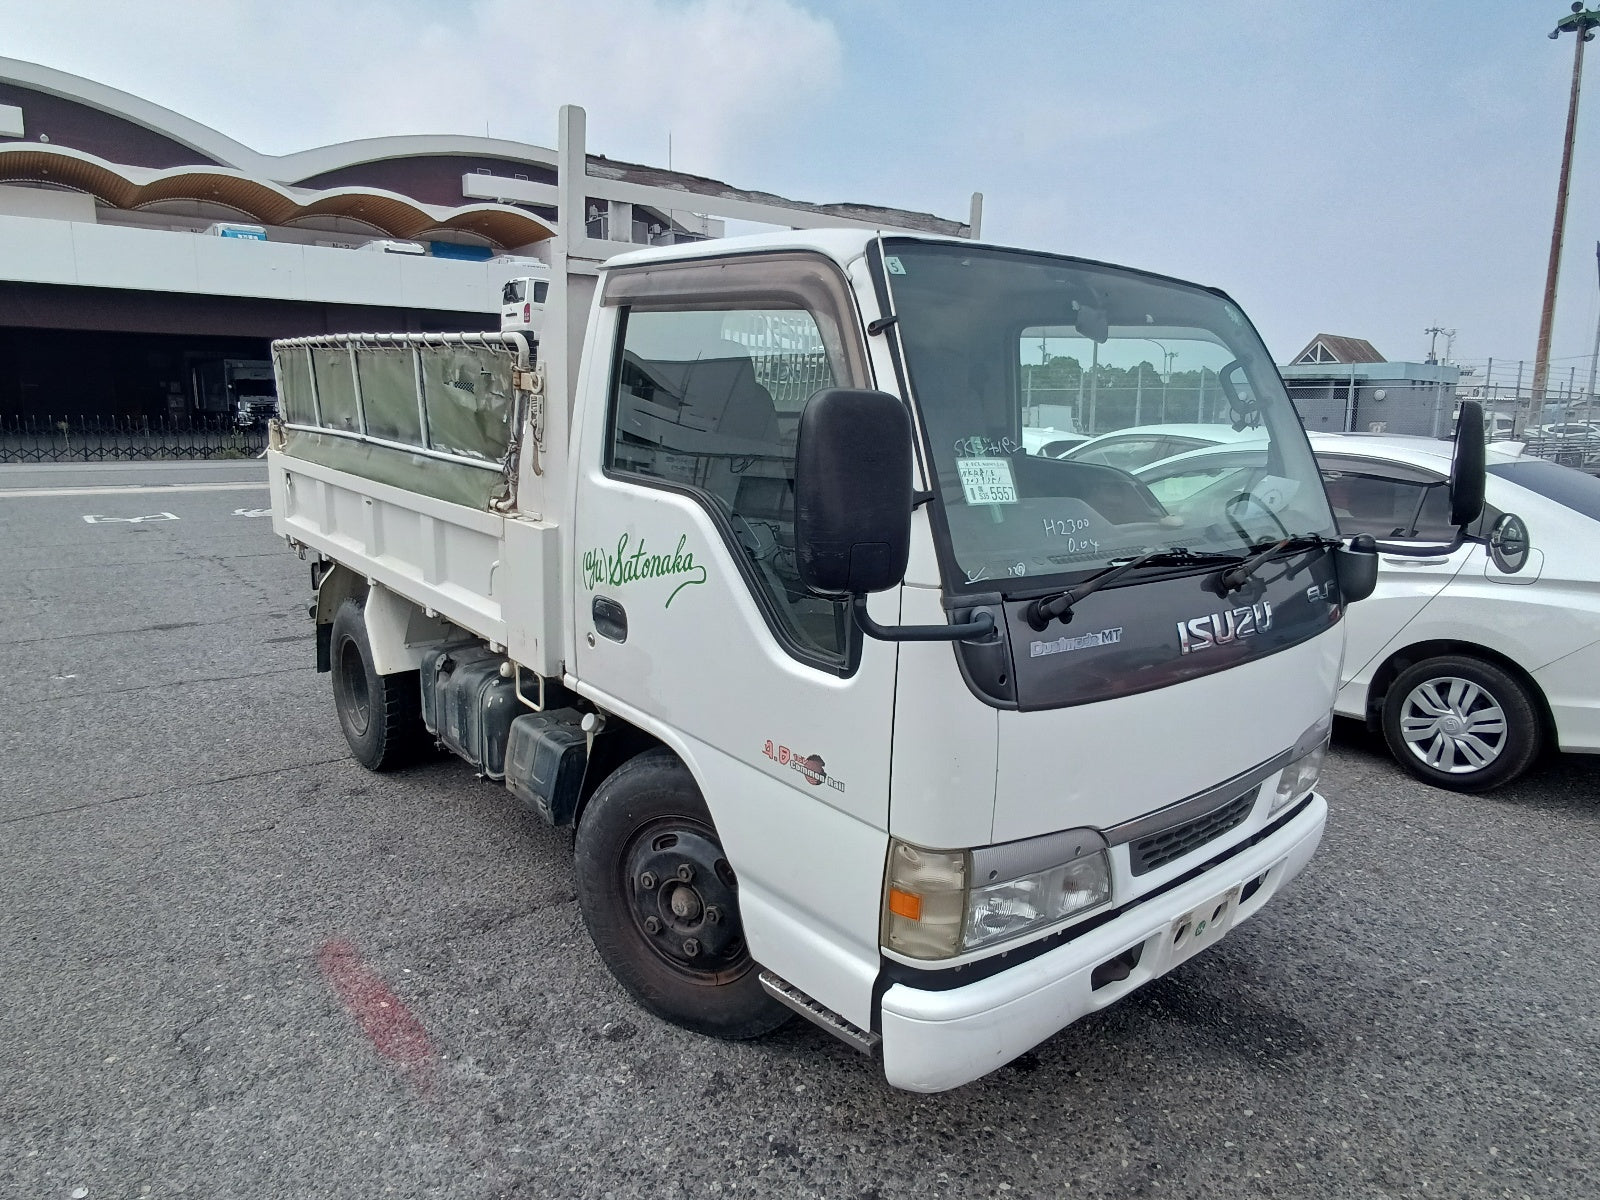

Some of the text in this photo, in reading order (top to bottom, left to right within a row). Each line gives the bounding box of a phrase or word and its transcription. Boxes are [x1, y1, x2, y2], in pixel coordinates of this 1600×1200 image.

[990, 486, 1015, 501] 5557
[1043, 518, 1090, 537] H2300
[609, 533, 706, 606] Satonaka
[1101, 628, 1122, 645] MT
[1177, 601, 1273, 656] ISUZU
[790, 759, 846, 793] Common Rail
